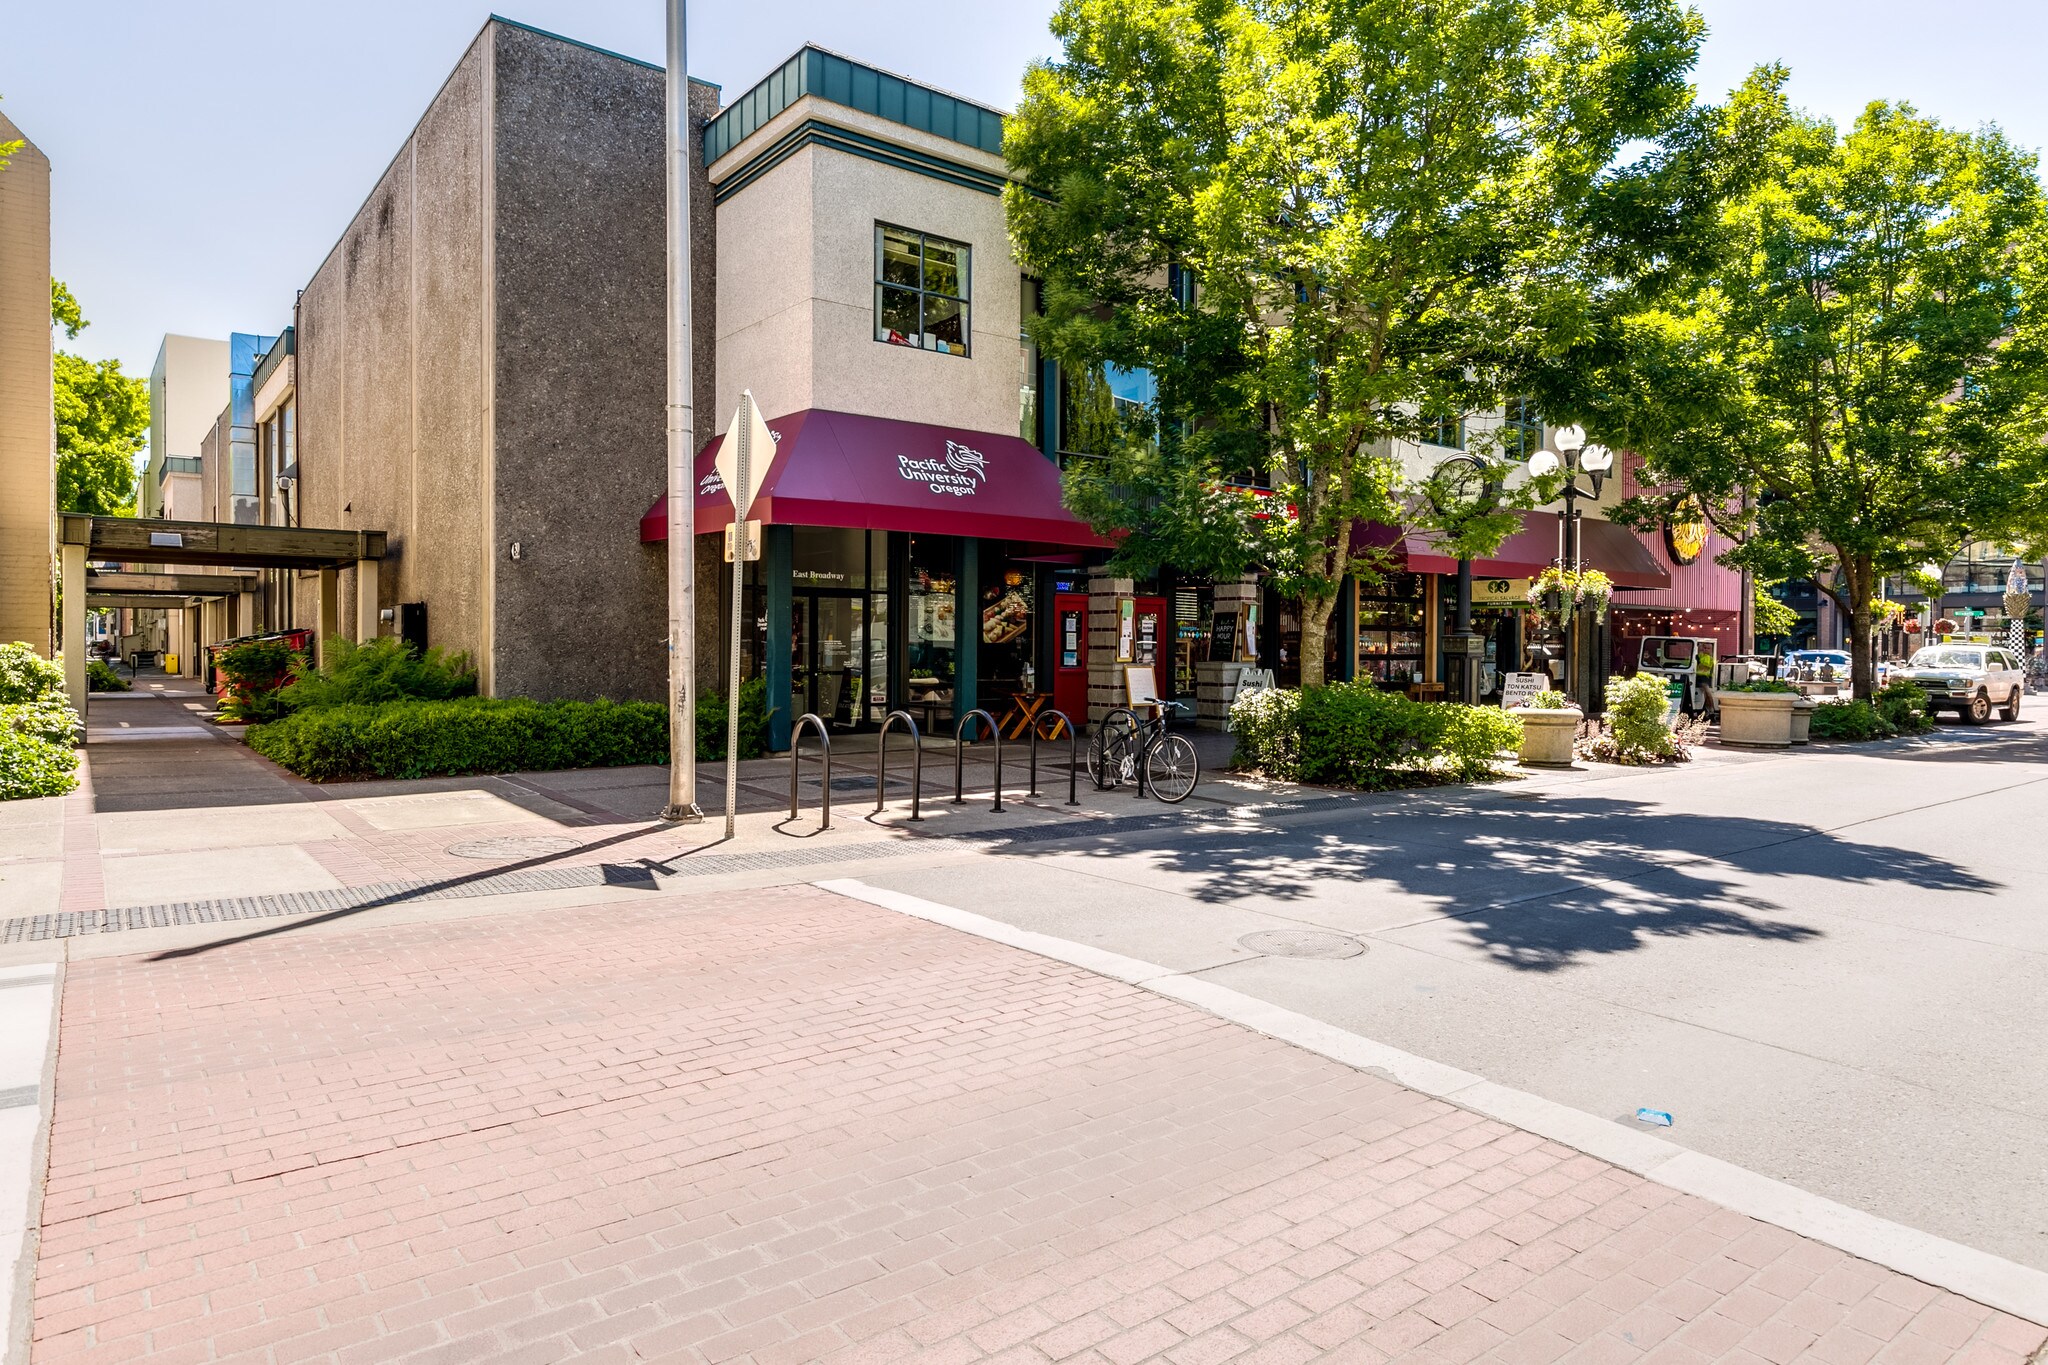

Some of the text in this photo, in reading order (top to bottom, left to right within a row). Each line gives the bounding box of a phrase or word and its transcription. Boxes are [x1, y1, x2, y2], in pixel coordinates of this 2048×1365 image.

[898, 455, 949, 472] Pacific
[899, 467, 976, 488] University
[930, 483, 975, 496] Oregon
[793, 570, 845, 581] East Broadway
